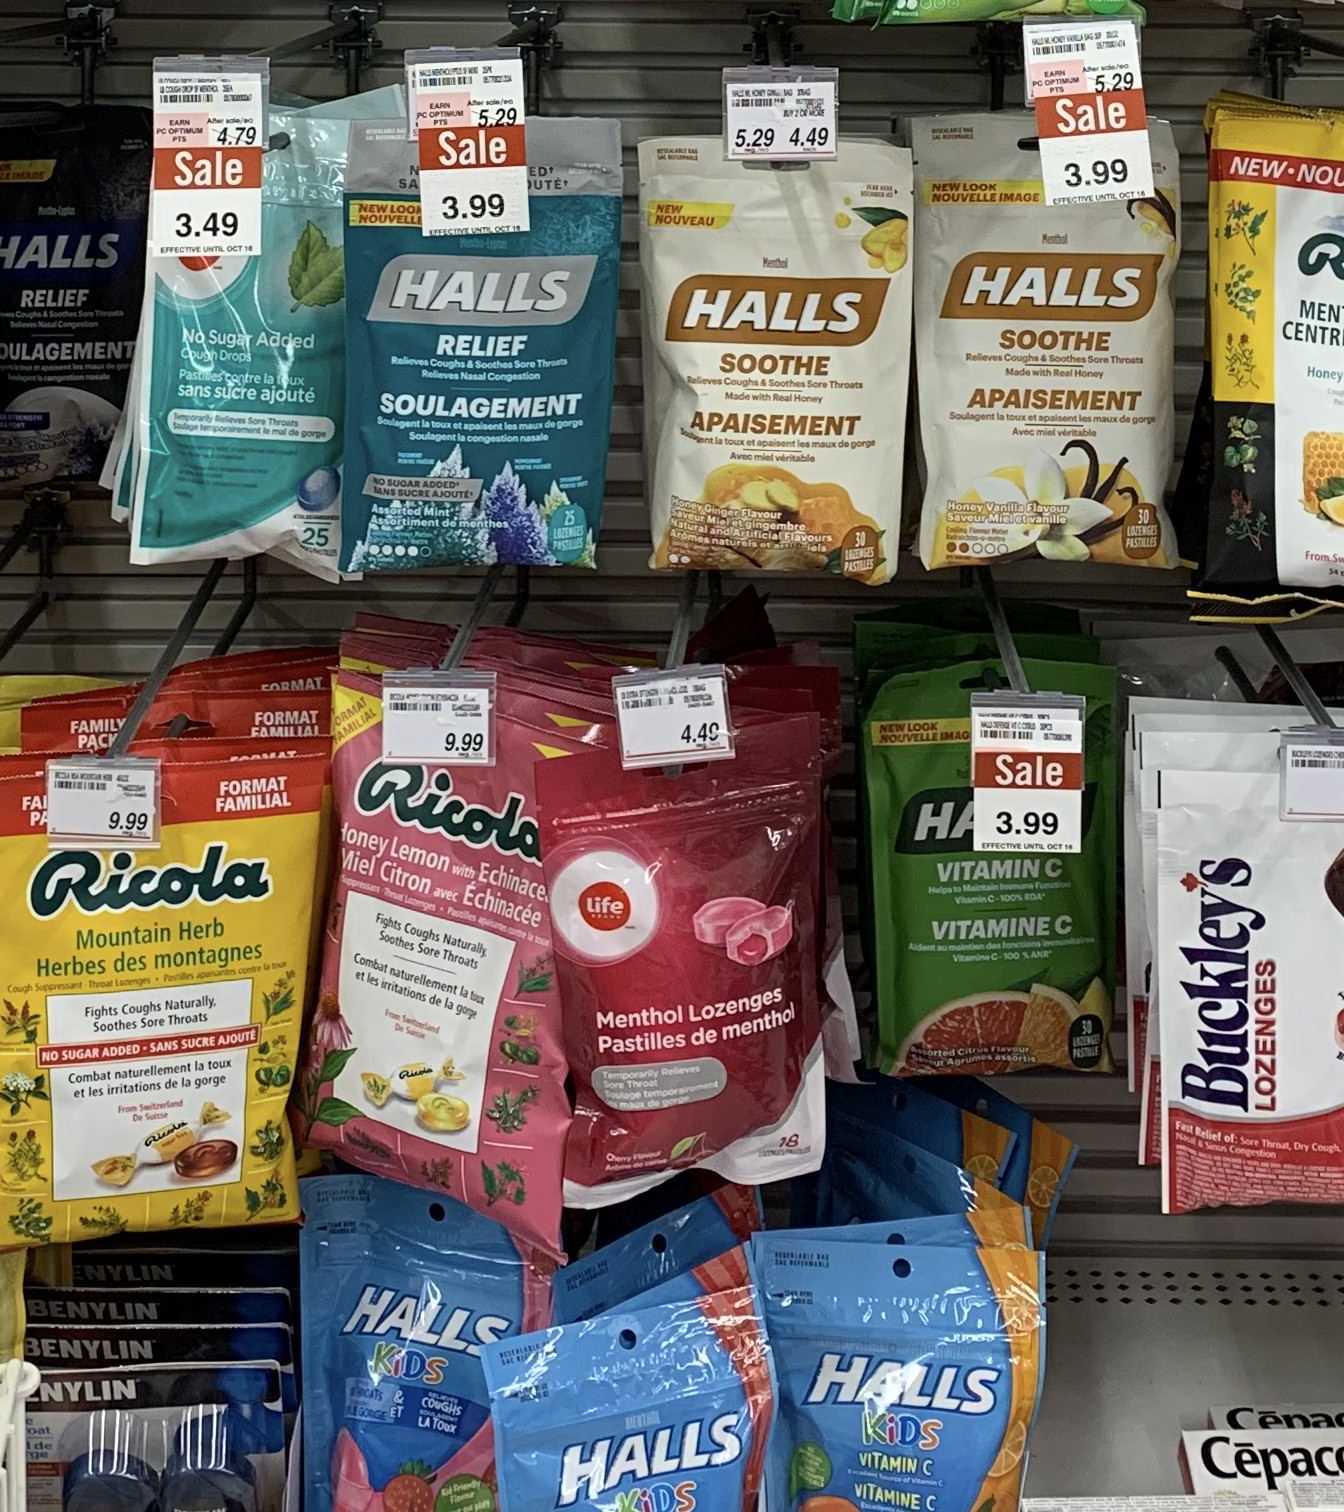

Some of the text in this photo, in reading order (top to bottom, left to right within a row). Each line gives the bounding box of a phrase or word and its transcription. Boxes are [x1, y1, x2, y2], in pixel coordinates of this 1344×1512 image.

[175, 150, 243, 187] Sale
[175, 212, 239, 237] 3.49
[655, 214, 715, 226] NOUVEAU
[1006, 368, 1104, 379] Made with Real Honey
[219, 776, 287, 796] FORMAT
[994, 754, 1064, 788] Sale
[215, 792, 291, 812] FAMILIAL
[996, 810, 1058, 836] 3.99
[31, 846, 270, 920] Ricola
[76, 918, 224, 950] Mountain Herb
[37, 945, 262, 977] Herbes des montagnes
[1179, 857, 1267, 1114] Buckley's
[597, 989, 782, 1030] Menthol Lozenges
[1253, 959, 1277, 1112] LOZENGES
[42, 1045, 140, 1061] NO SUGAR ADDED
[804, 1354, 1000, 1416] HALLS
